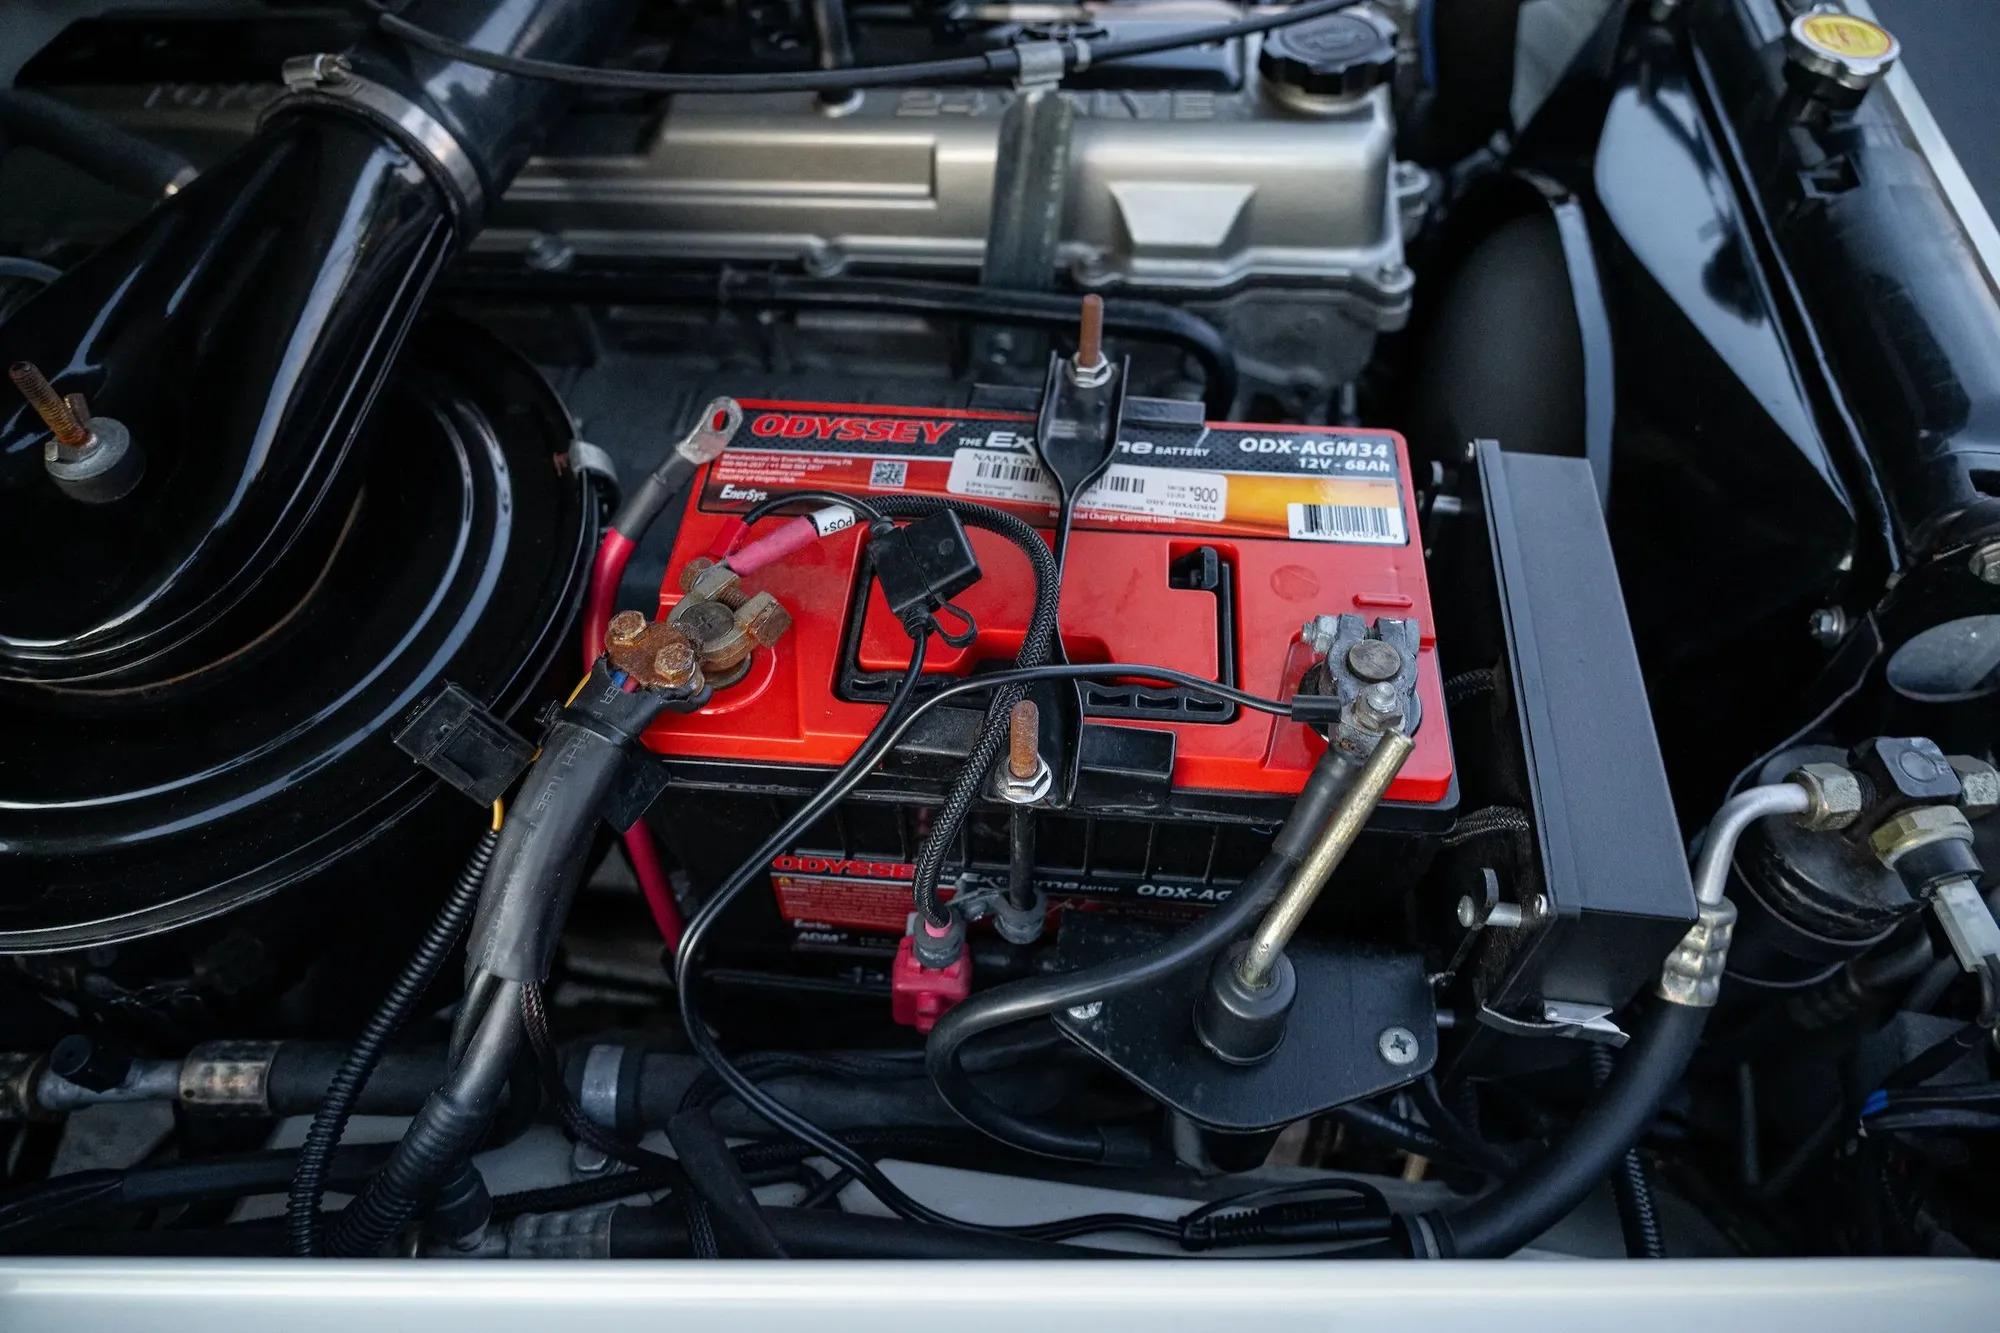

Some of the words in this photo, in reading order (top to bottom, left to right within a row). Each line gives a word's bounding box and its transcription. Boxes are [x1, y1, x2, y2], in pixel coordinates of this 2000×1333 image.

[752, 413, 956, 444] ODYSSEY
[958, 437, 983, 447] THE
[1154, 446, 1210, 457] BATTERY
[1238, 437, 1388, 459] ODX-AGM34
[973, 453, 1009, 464] NAPA
[1299, 457, 1332, 470] 12V
[1344, 459, 1390, 473] 68Ah
[719, 484, 768, 502] EnerSys
[823, 515, 853, 534] POS+
[1089, 511, 1119, 523] Charge
[1119, 514, 1153, 523] Current
[1153, 515, 1176, 524] Limit
[771, 854, 916, 880] ODYSSE
